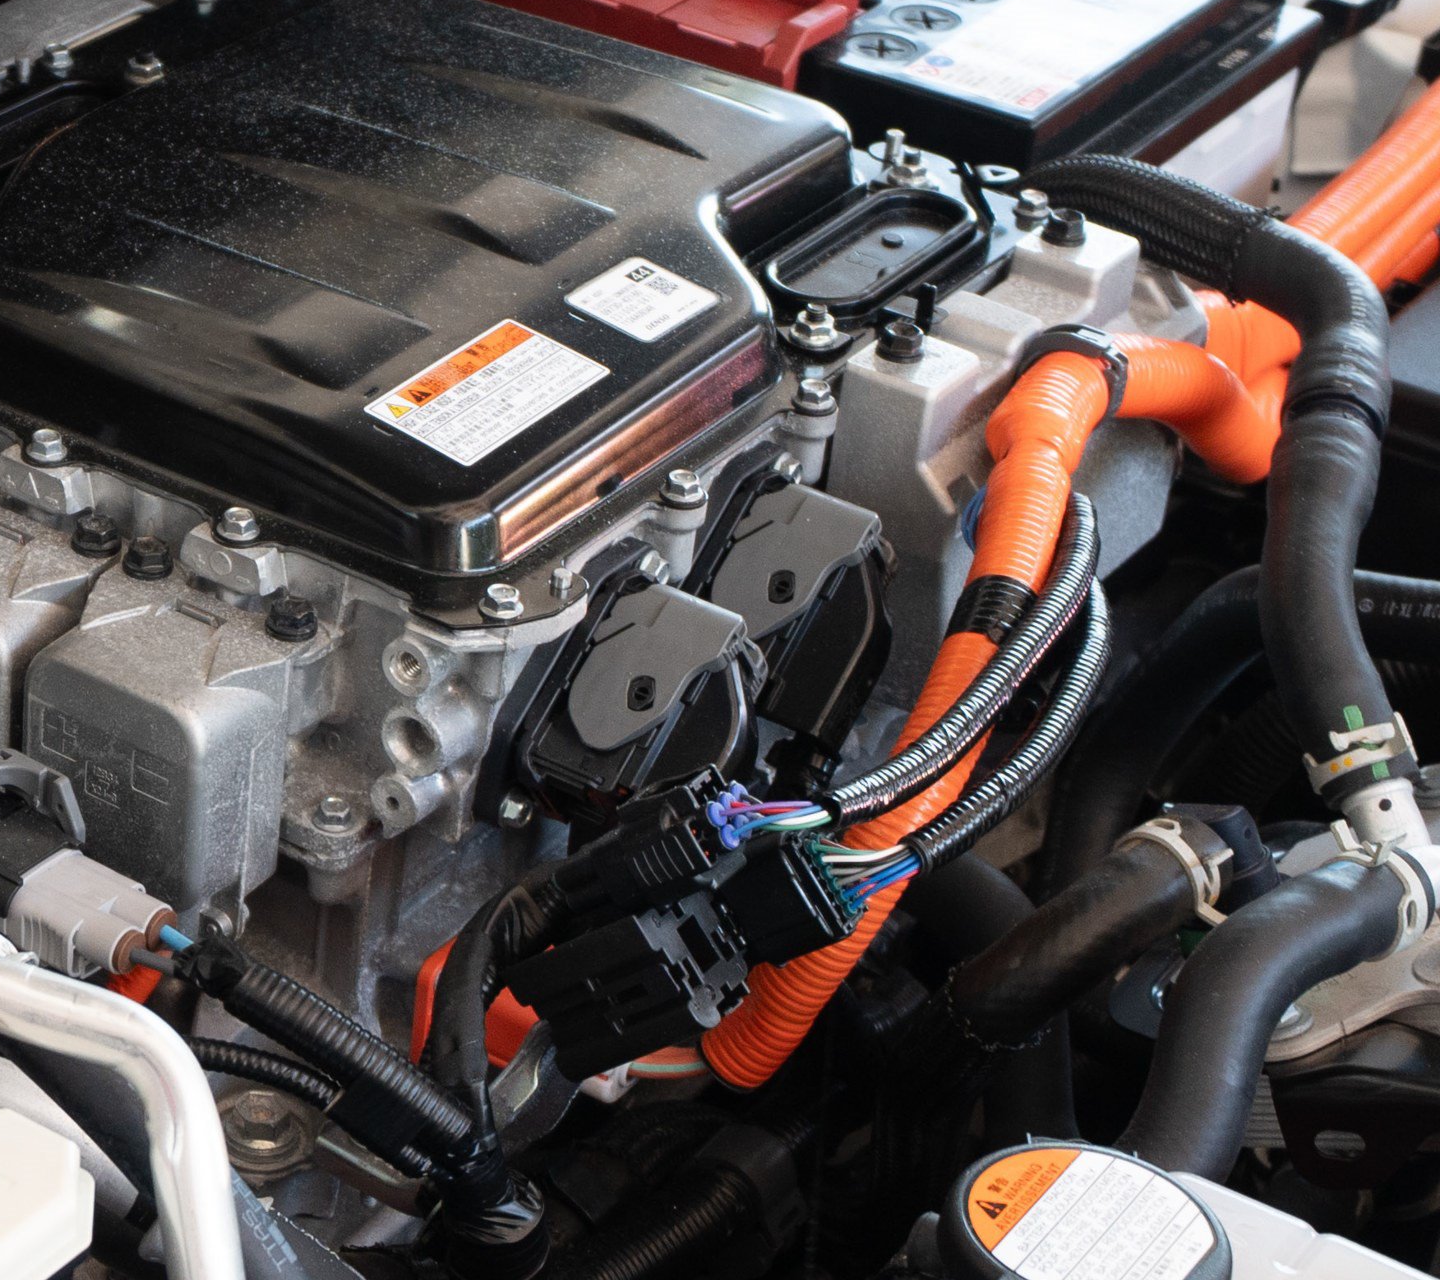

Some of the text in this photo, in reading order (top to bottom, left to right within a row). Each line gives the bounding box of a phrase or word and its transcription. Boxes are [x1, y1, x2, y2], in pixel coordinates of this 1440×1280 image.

[626, 266, 651, 280] 44
[987, 1177, 1009, 1194] 警告
[994, 1162, 1061, 1231] AVERTISSEMENT
[1005, 1163, 1042, 1201] WARNING
[1042, 1171, 1078, 1205] TRACTION
[1016, 1221, 1049, 1252] BATTERY
